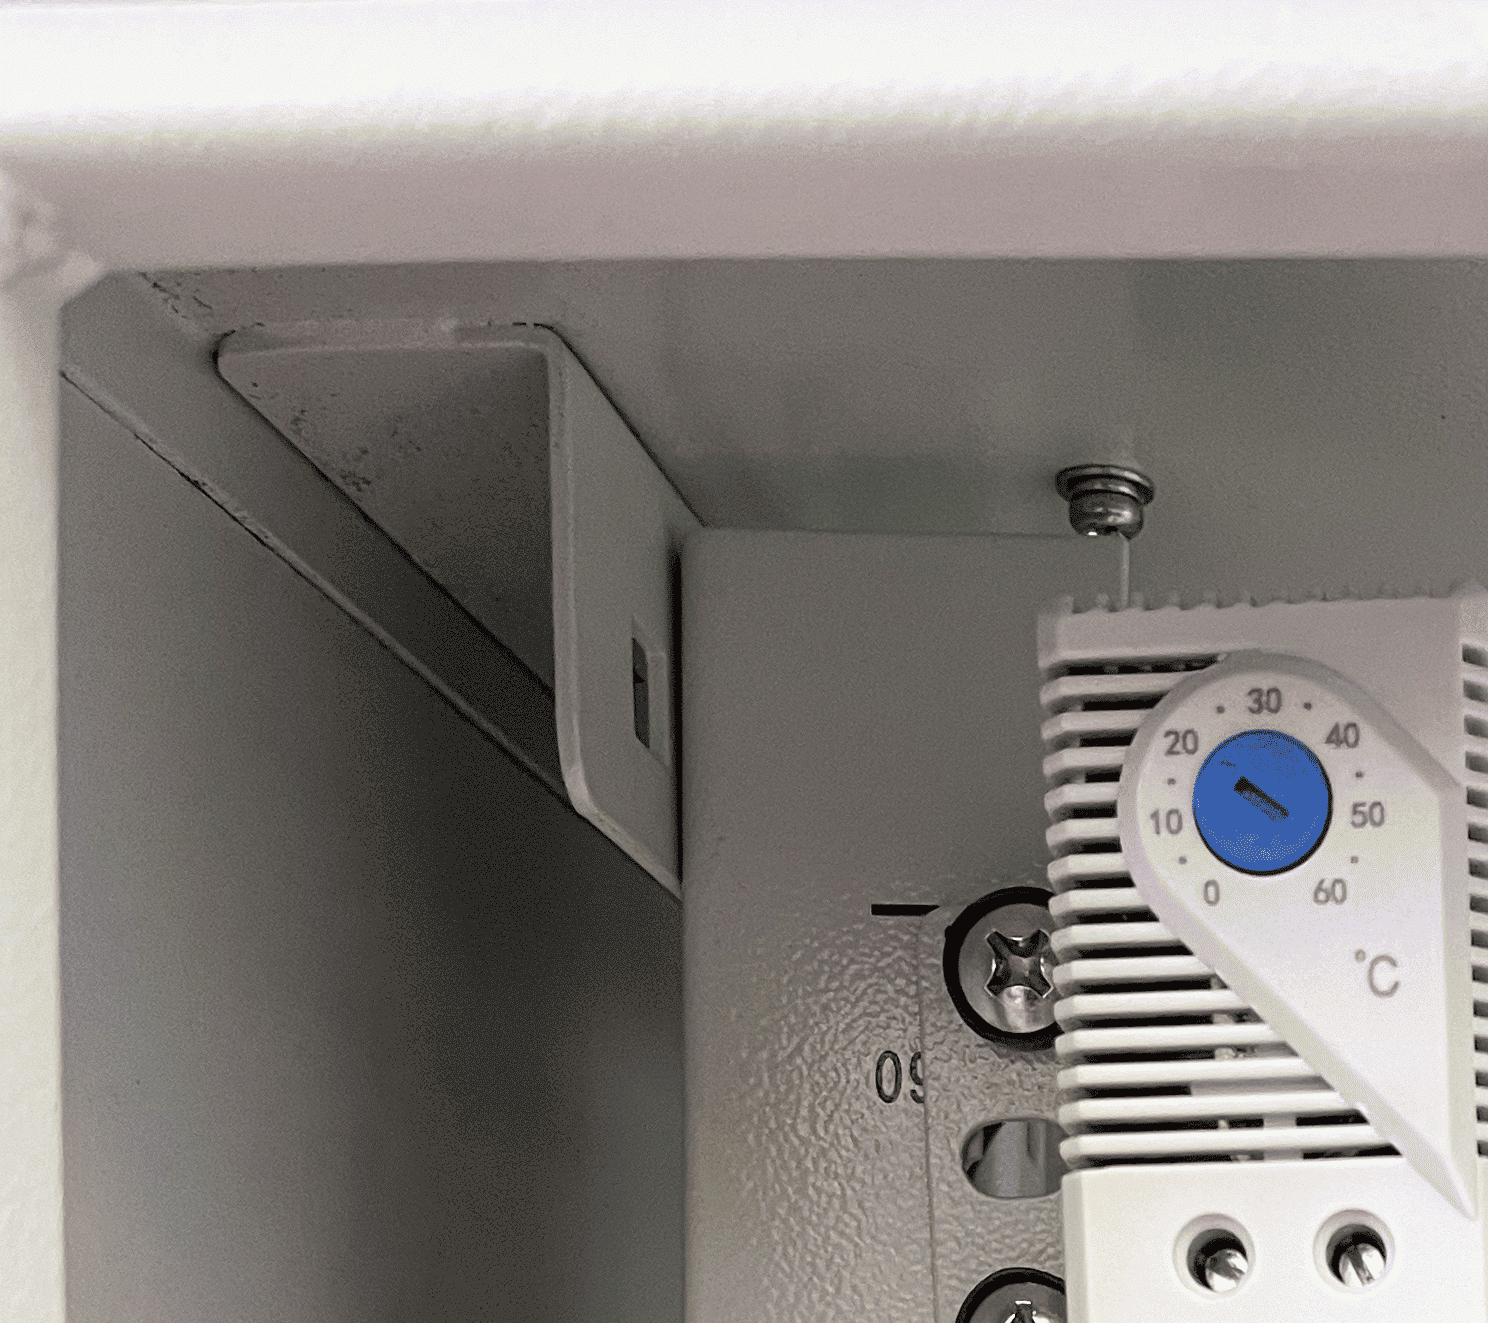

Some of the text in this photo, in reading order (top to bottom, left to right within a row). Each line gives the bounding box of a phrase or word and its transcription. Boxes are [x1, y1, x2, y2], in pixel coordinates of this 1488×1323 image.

[1247, 686, 1283, 715] 30
[1163, 727, 1200, 757] 20
[1325, 721, 1361, 749] 40
[1149, 808, 1184, 836] 10
[1350, 800, 1386, 829] 50
[1202, 878, 1221, 907] 0
[1312, 877, 1348, 906] 60
[1353, 948, 1401, 999] °C
